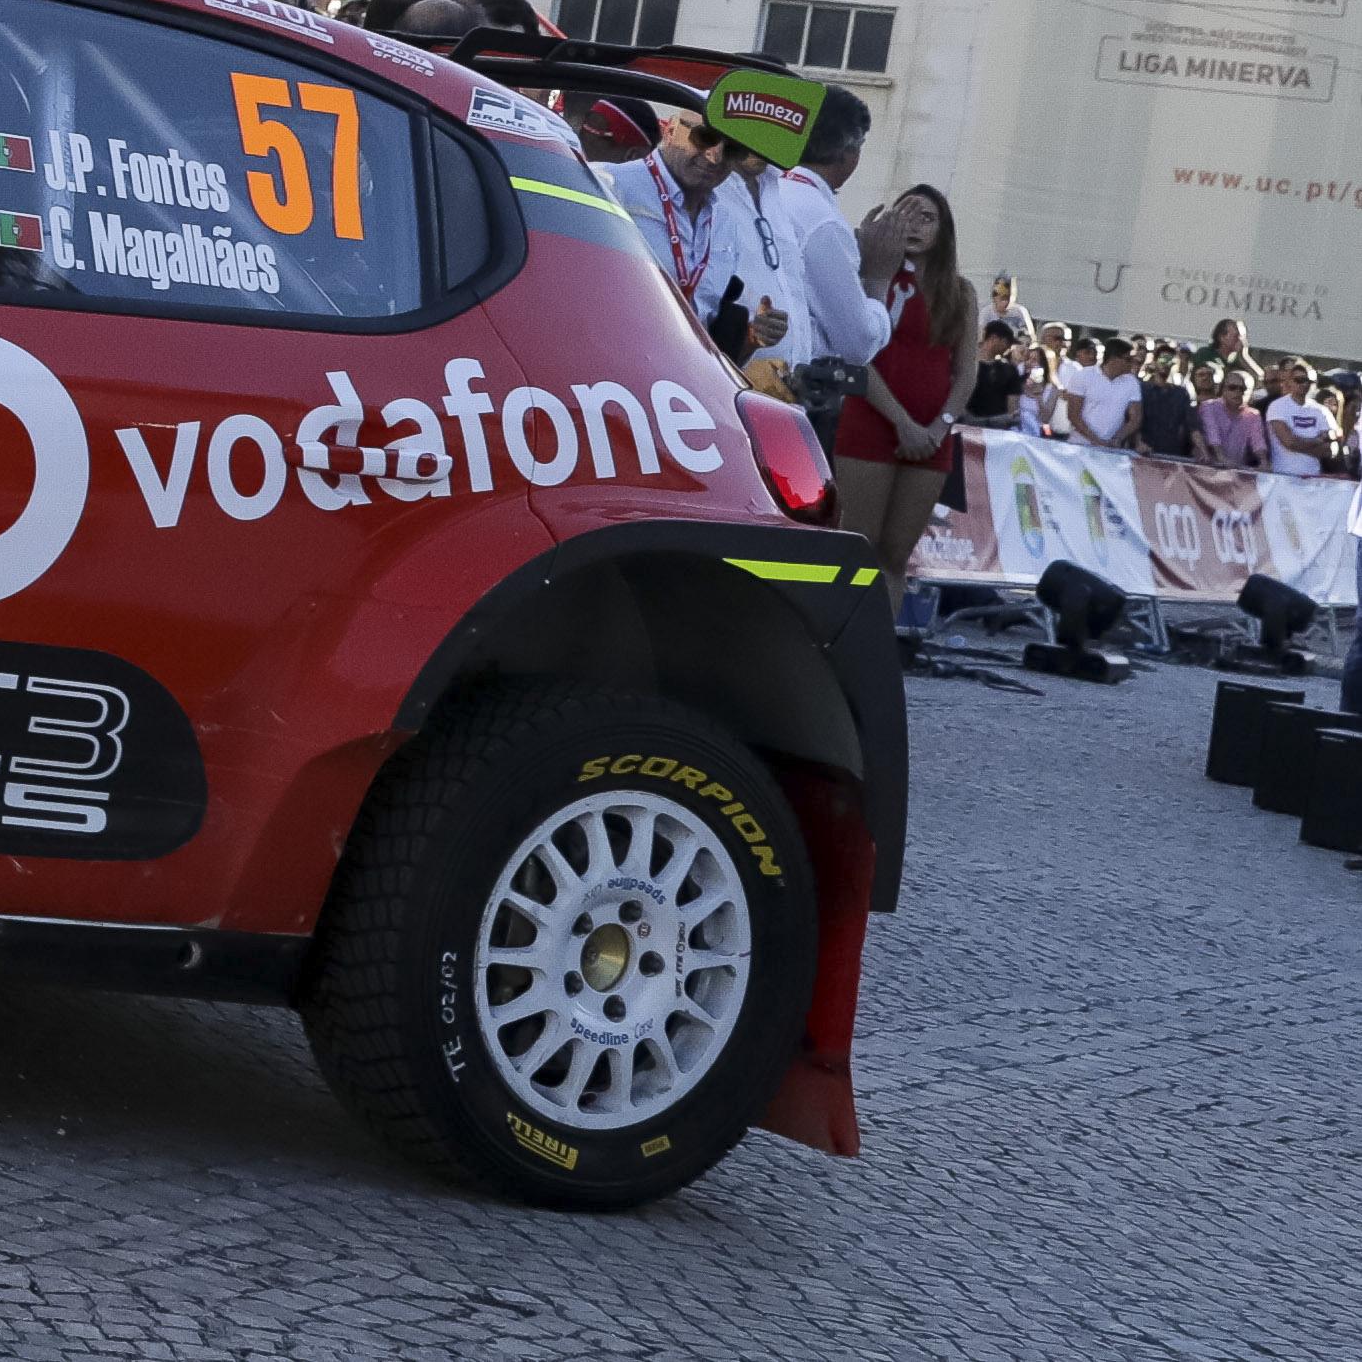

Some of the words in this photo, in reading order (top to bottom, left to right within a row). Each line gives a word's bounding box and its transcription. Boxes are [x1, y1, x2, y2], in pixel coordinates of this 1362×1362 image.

[1118, 49, 1178, 77] LIGA
[1184, 58, 1312, 90] MINERVA
[726, 93, 804, 127] Milaneza
[109, 138, 230, 213] Fontes
[229, 71, 365, 241] 57
[48, 205, 86, 271] C.
[87, 209, 281, 294] Magalhães
[1160, 281, 1324, 321] COIMBRA
[113, 356, 725, 529] vodafone
[577, 753, 783, 878] SCORPION
[606, 877, 668, 906] speedline
[569, 1016, 630, 1046] speedline
